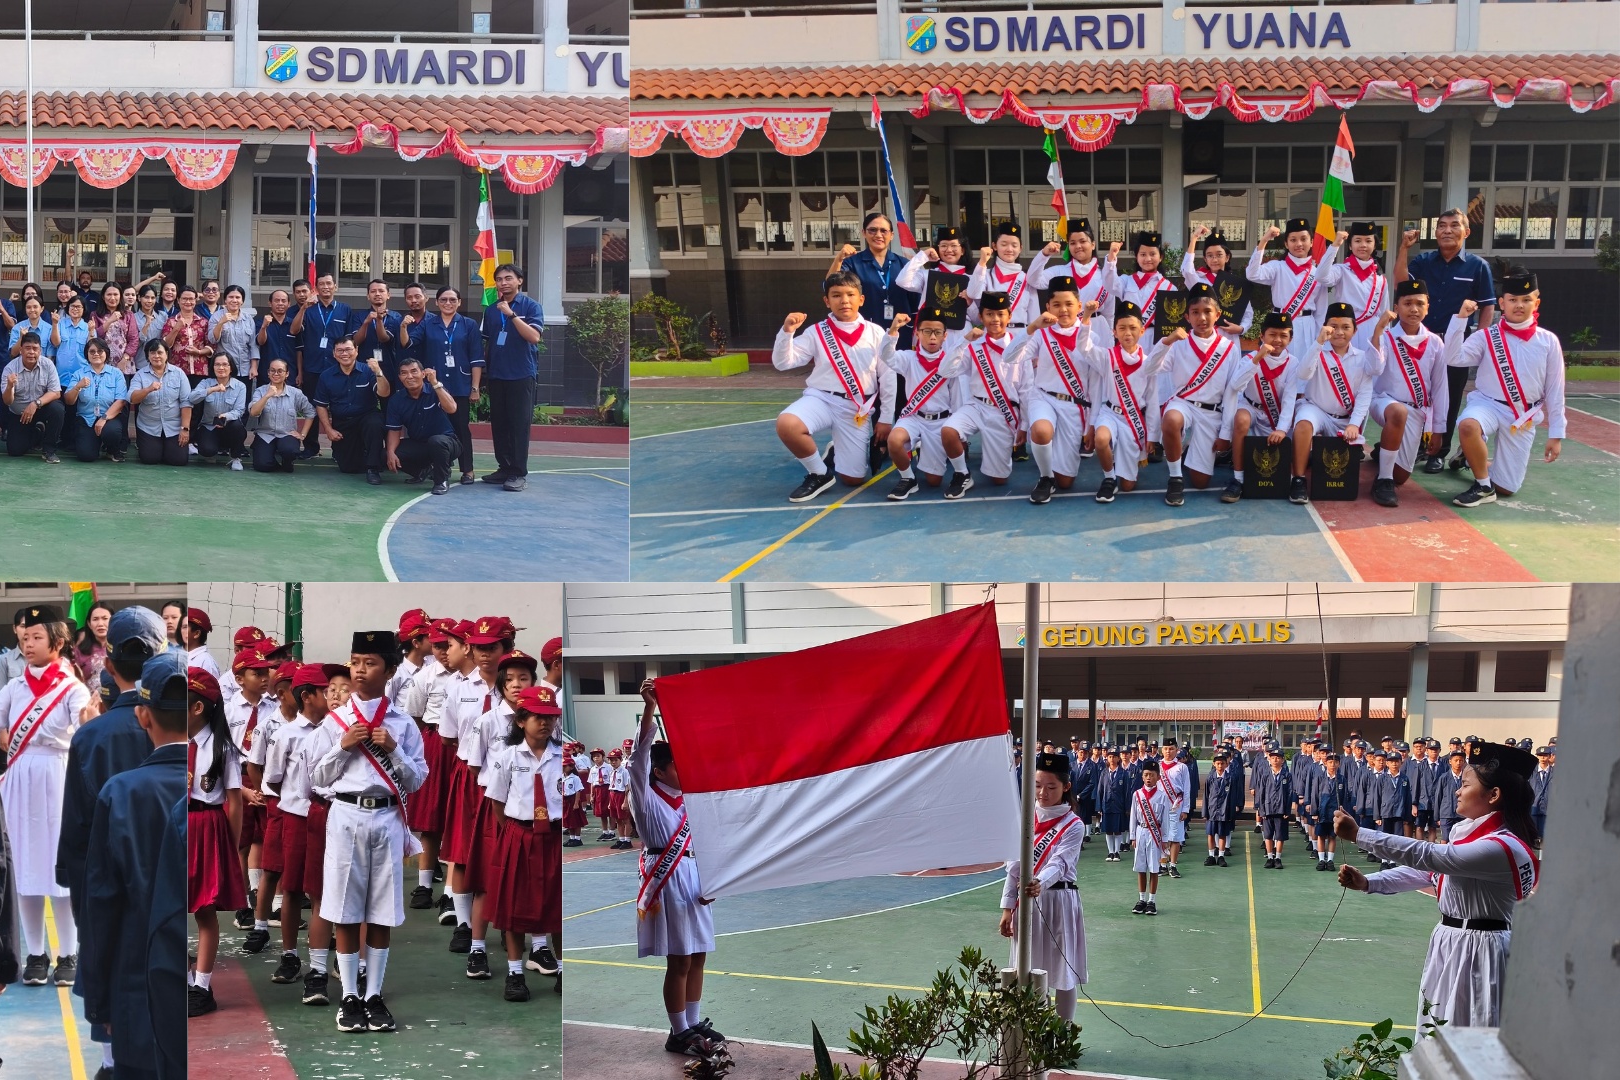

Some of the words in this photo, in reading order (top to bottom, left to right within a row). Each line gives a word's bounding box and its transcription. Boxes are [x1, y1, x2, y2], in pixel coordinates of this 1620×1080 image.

[1192, 11, 1351, 50] YUANA
[1009, 279, 1023, 305] PENGIB
[820, 321, 842, 360] PEMIMPIN
[836, 358, 859, 396] BARISAN
[1050, 341, 1074, 380] PEMIMPIN
[1492, 325, 1508, 365] PEMIMPIN
[1501, 365, 1521, 403] BARISAN
[911, 373, 943, 407] PEMBINA
[975, 348, 998, 389] PEMIMPIN
[992, 387, 1014, 423] BARISAN
[1113, 369, 1134, 409] PEMIMPIN
[1041, 625, 1146, 647] GEDUNG
[1156, 620, 1291, 645] PASKALIS
[8, 704, 44, 759] DIRIGEN
[653, 837, 683, 880] PENGIBAR
